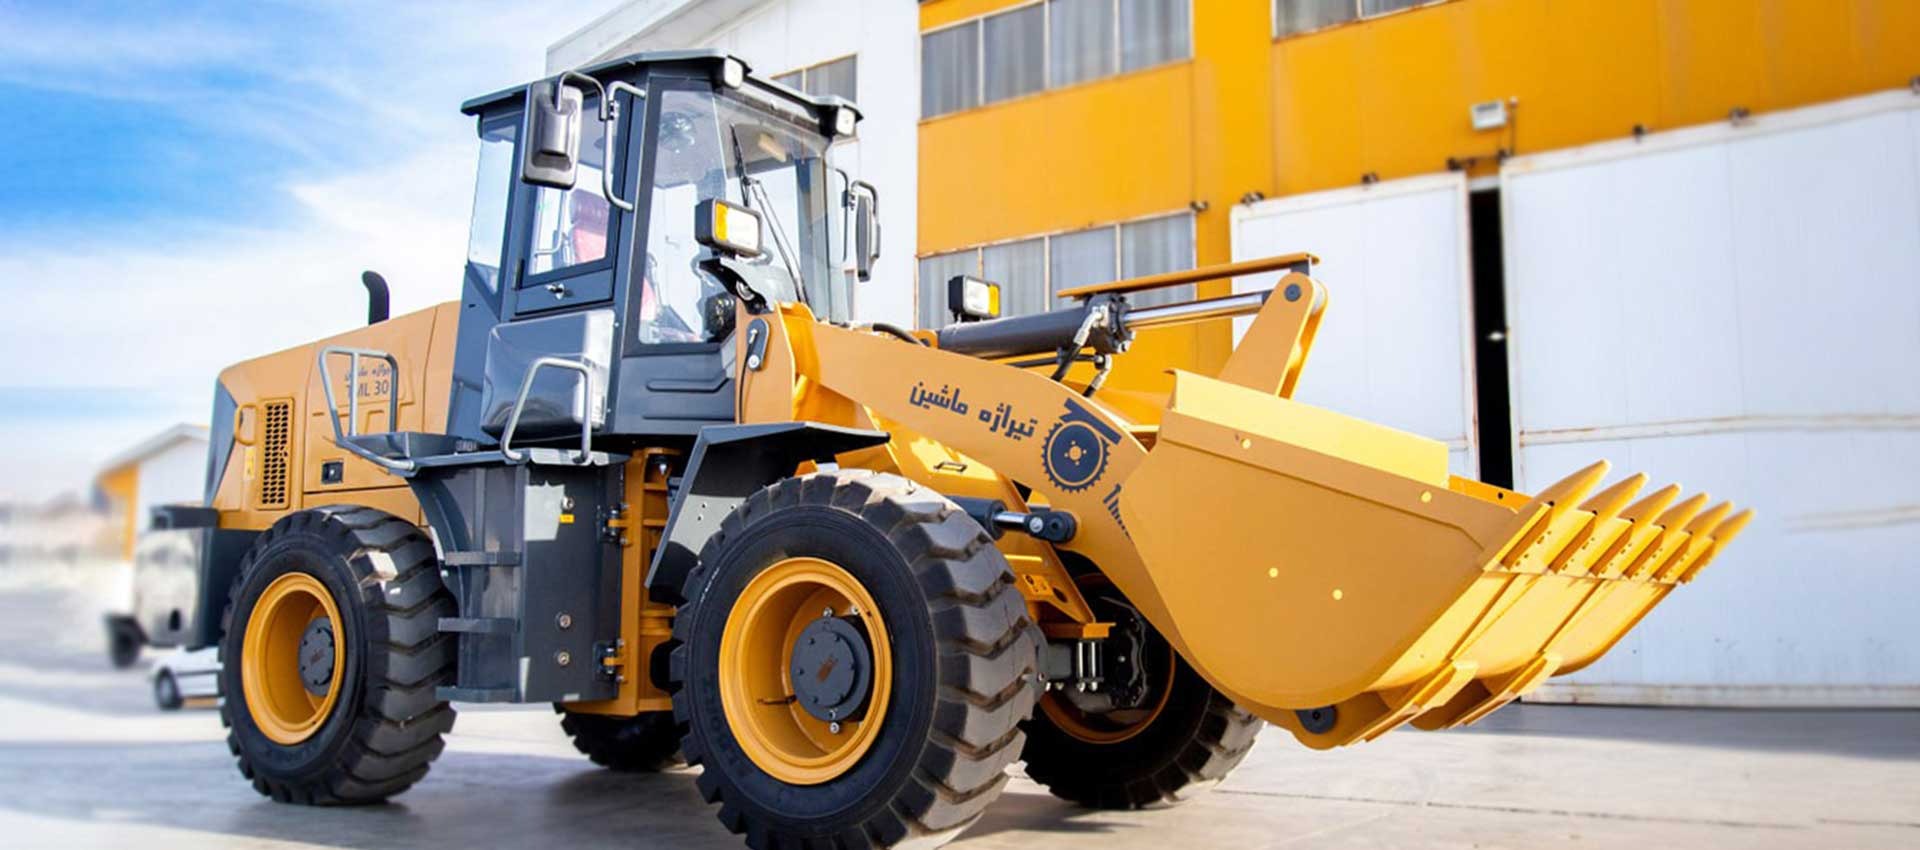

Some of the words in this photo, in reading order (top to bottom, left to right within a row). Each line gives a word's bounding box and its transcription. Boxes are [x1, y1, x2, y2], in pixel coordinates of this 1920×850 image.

[374, 379, 389, 396] 30
[909, 381, 968, 415] ماشین
[978, 402, 1038, 441] تیراژه
